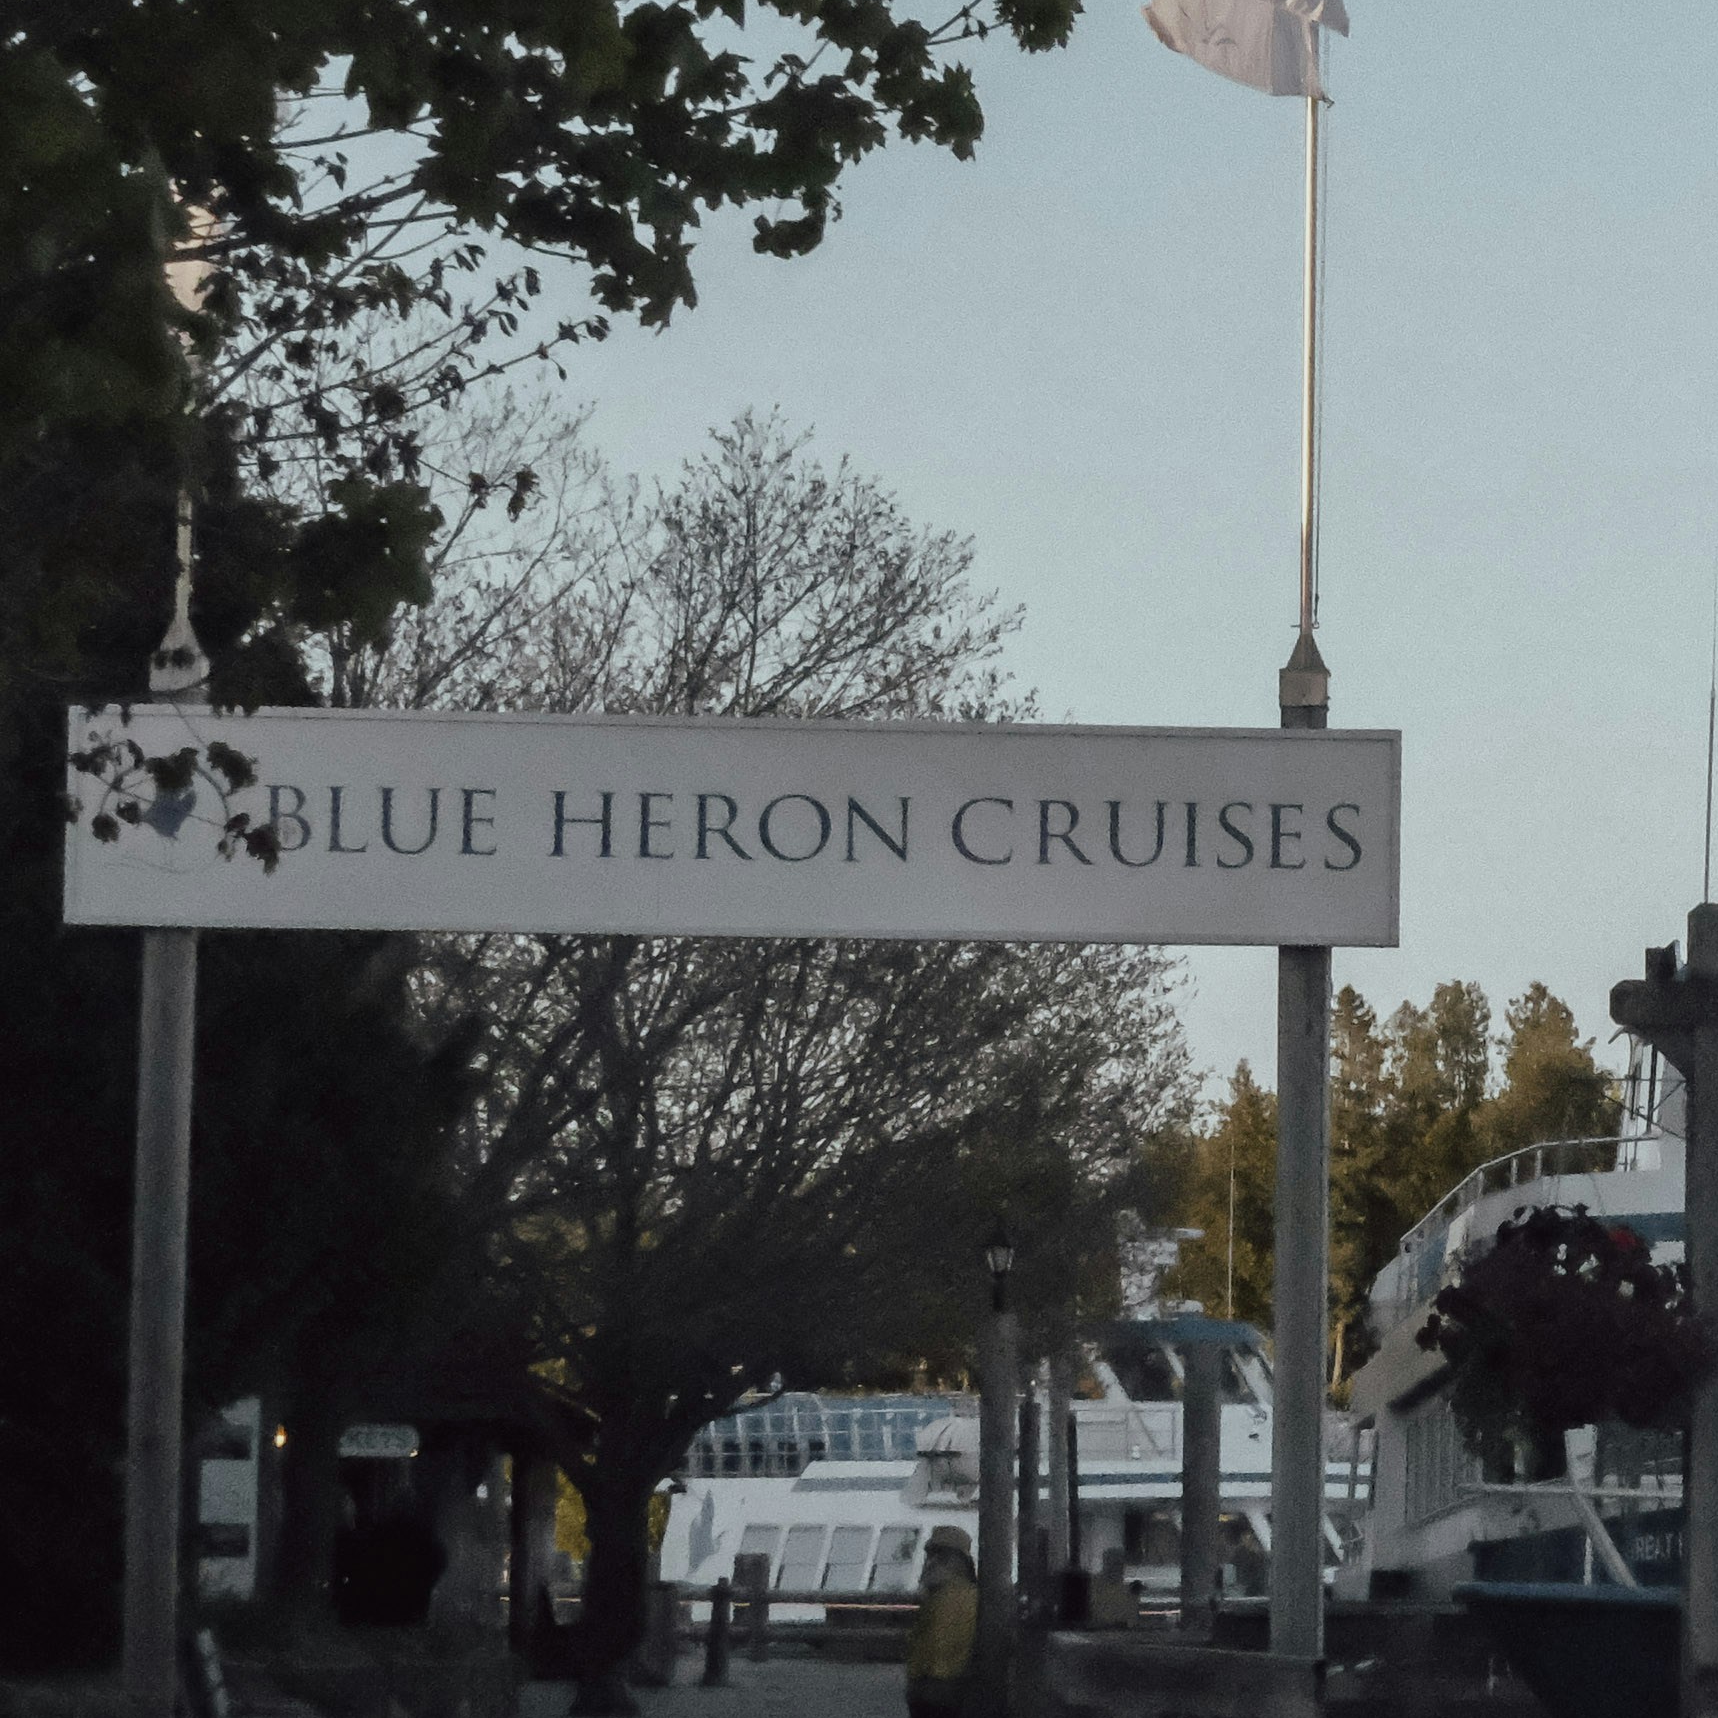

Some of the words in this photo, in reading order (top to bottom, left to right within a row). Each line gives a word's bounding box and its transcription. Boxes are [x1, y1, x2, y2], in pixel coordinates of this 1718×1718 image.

[264, 783, 499, 856] BLUE
[549, 789, 913, 863] HERON
[950, 797, 1366, 873] CRUISES
